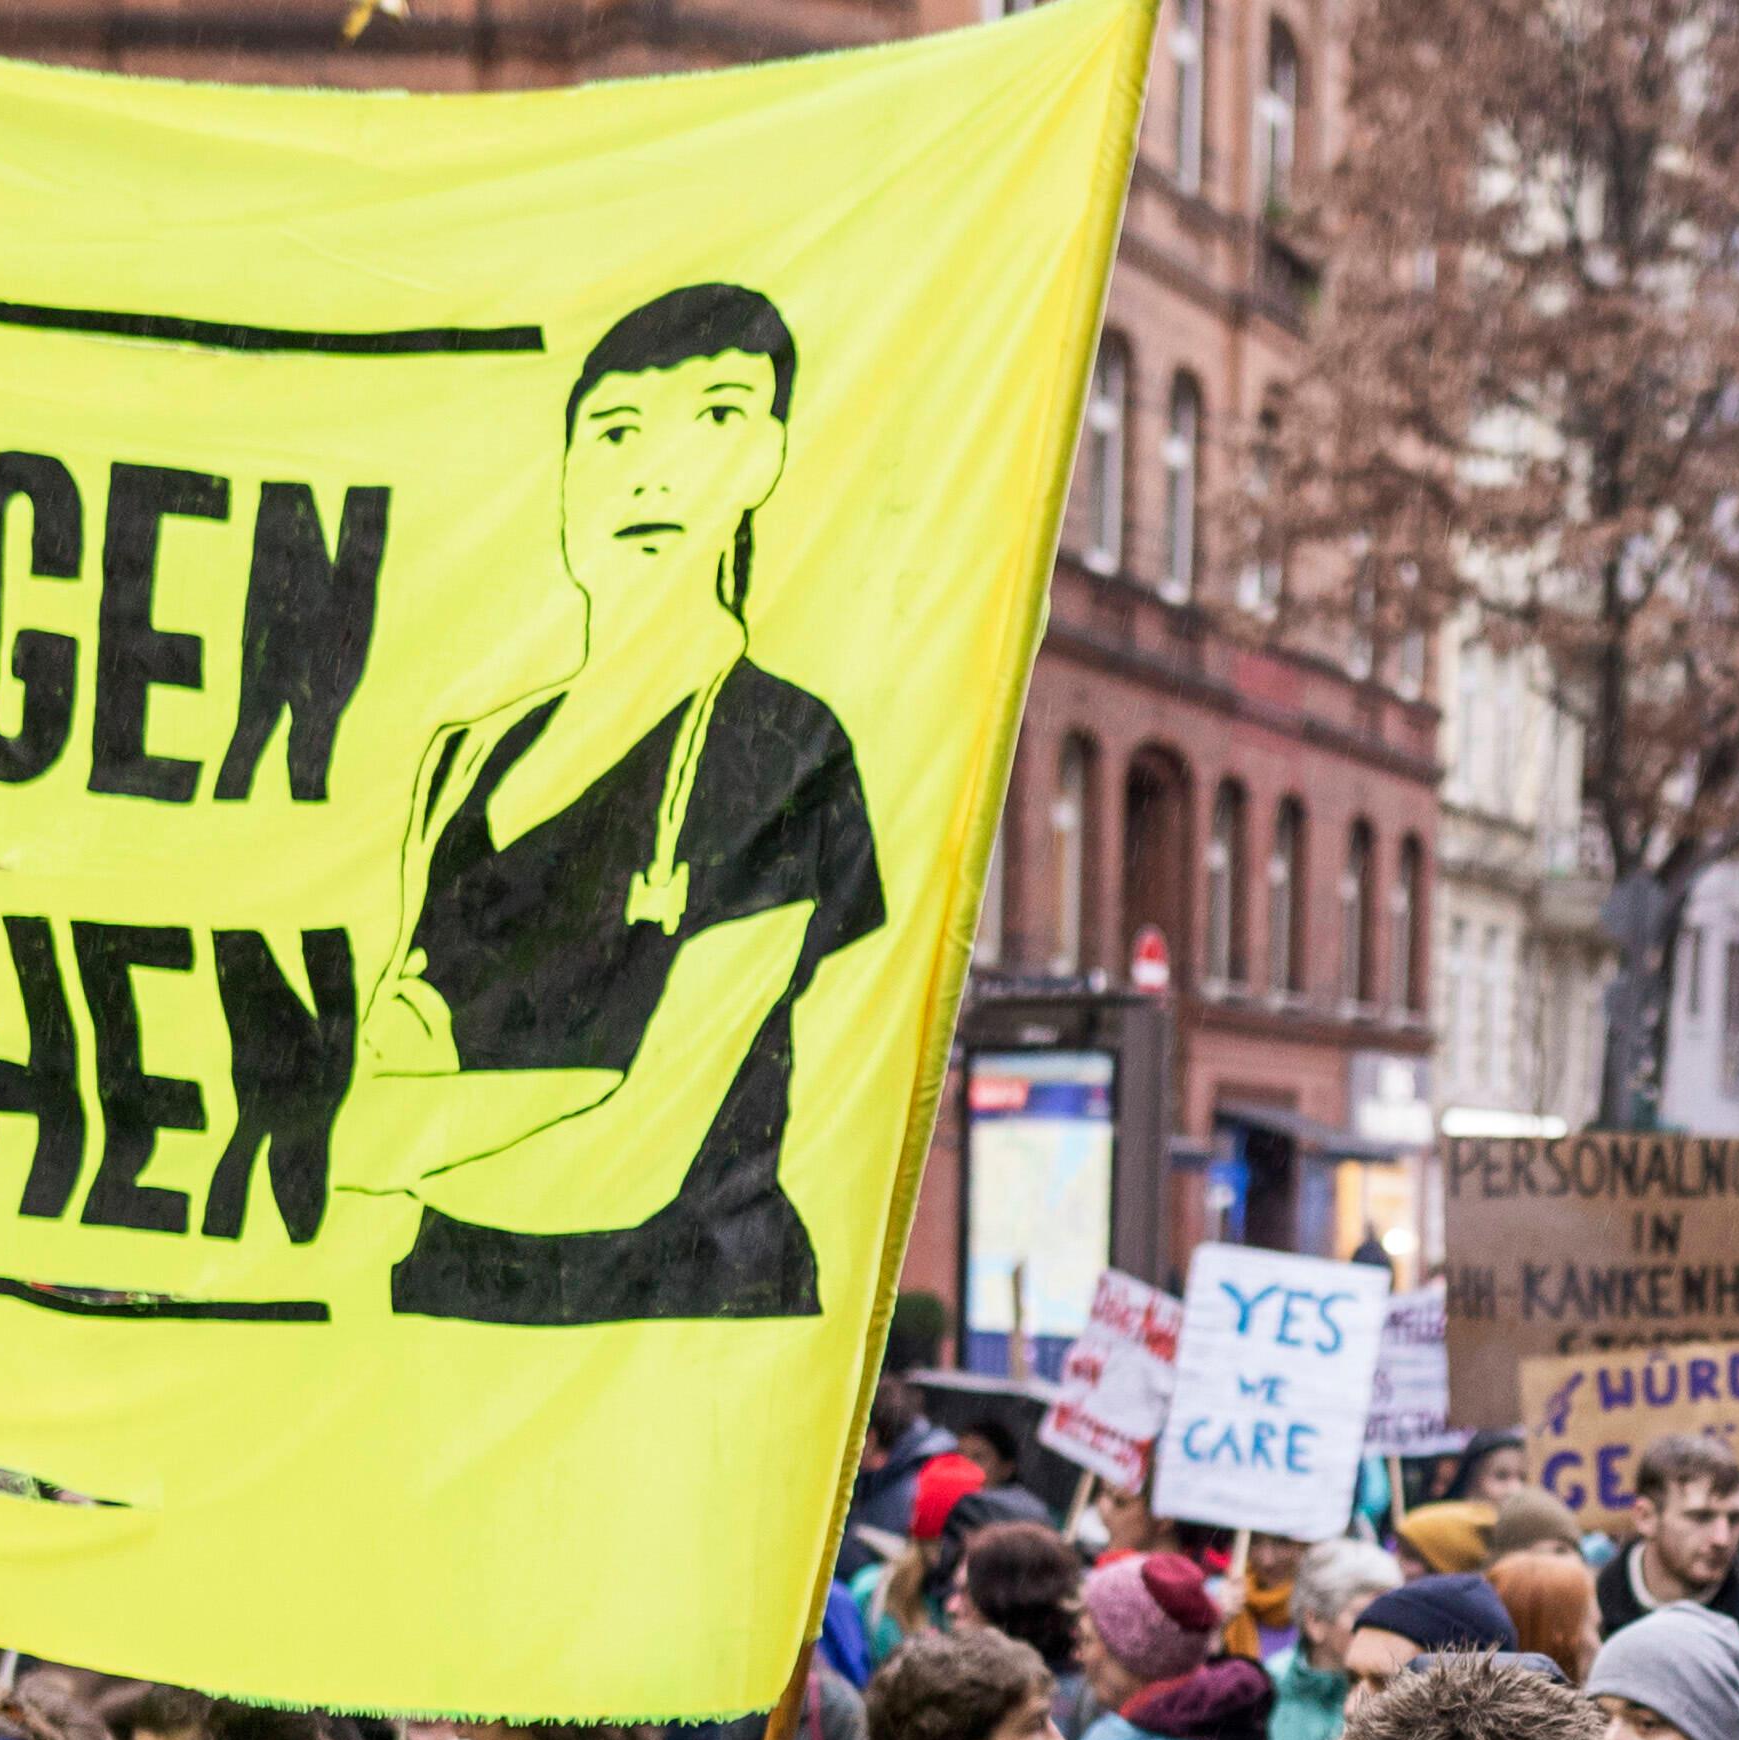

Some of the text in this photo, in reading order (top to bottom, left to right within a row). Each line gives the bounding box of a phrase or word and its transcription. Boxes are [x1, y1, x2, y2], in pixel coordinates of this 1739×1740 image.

[1633, 1212, 1683, 1255] IN
[1219, 1280, 1355, 1355] YES
[1237, 1373, 1293, 1406] WE
[1182, 1417, 1322, 1474] CARE
